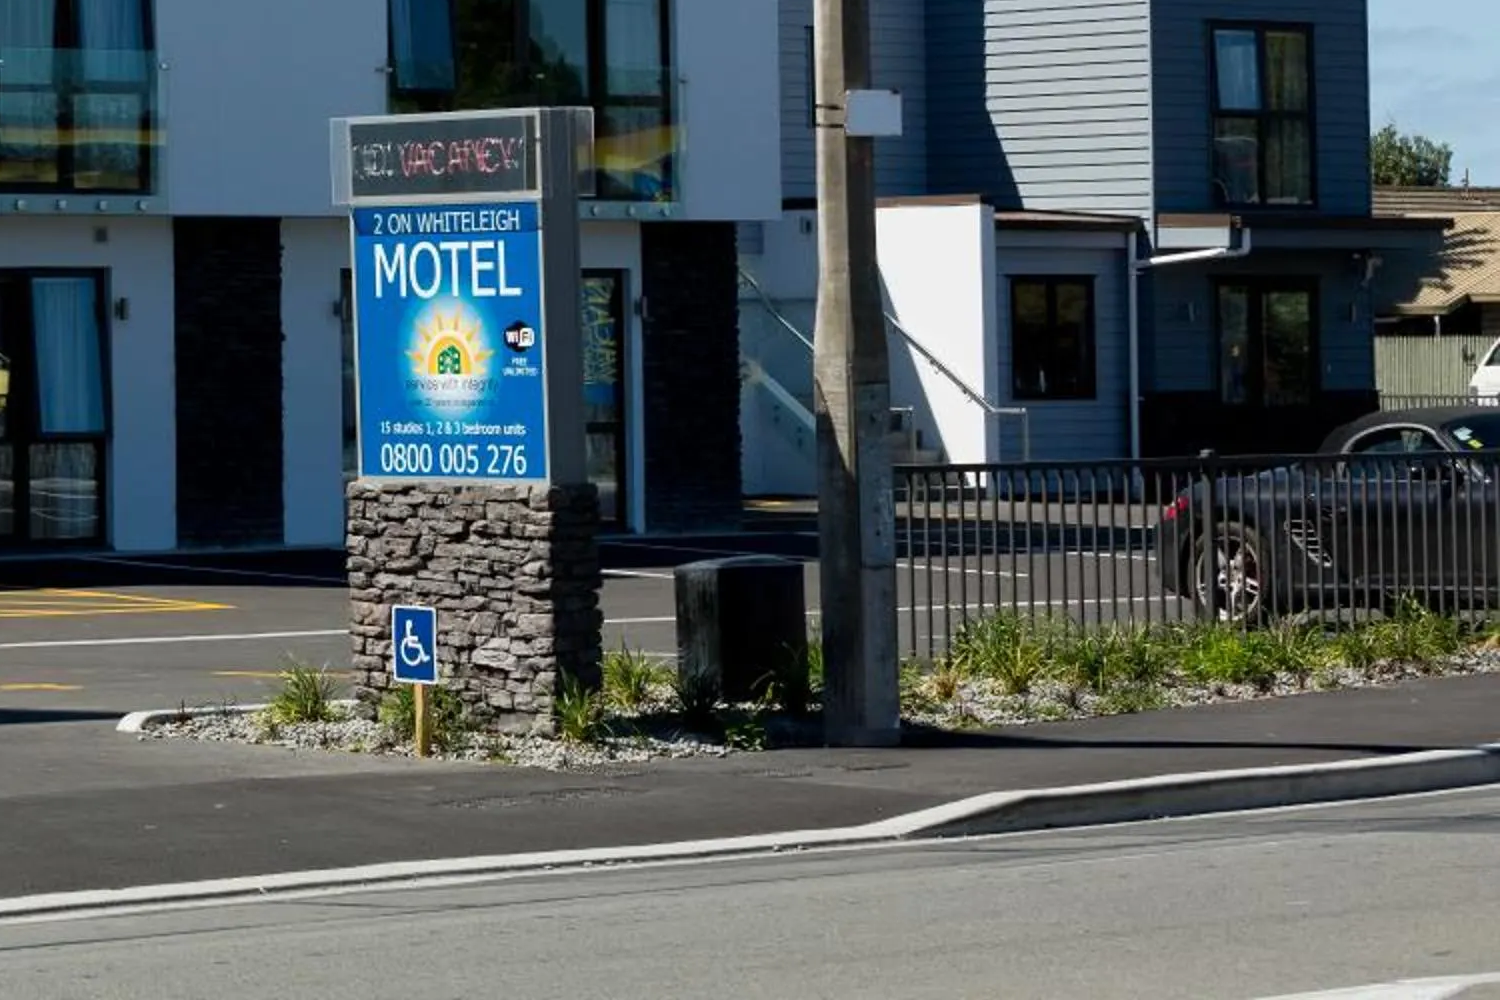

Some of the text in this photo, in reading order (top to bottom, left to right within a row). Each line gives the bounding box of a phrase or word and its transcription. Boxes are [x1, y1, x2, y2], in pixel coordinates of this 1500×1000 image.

[373, 209, 520, 235] 2 ON WHITELEIGH
[373, 239, 523, 298] MOTEL
[381, 421, 390, 433] 15
[393, 421, 423, 435] studios
[436, 421, 443, 434] 2
[445, 421, 452, 434] &
[454, 421, 461, 434] 3
[463, 422, 501, 435] bedroom
[503, 424, 527, 436] units
[381, 443, 527, 475] 0800 005 276
